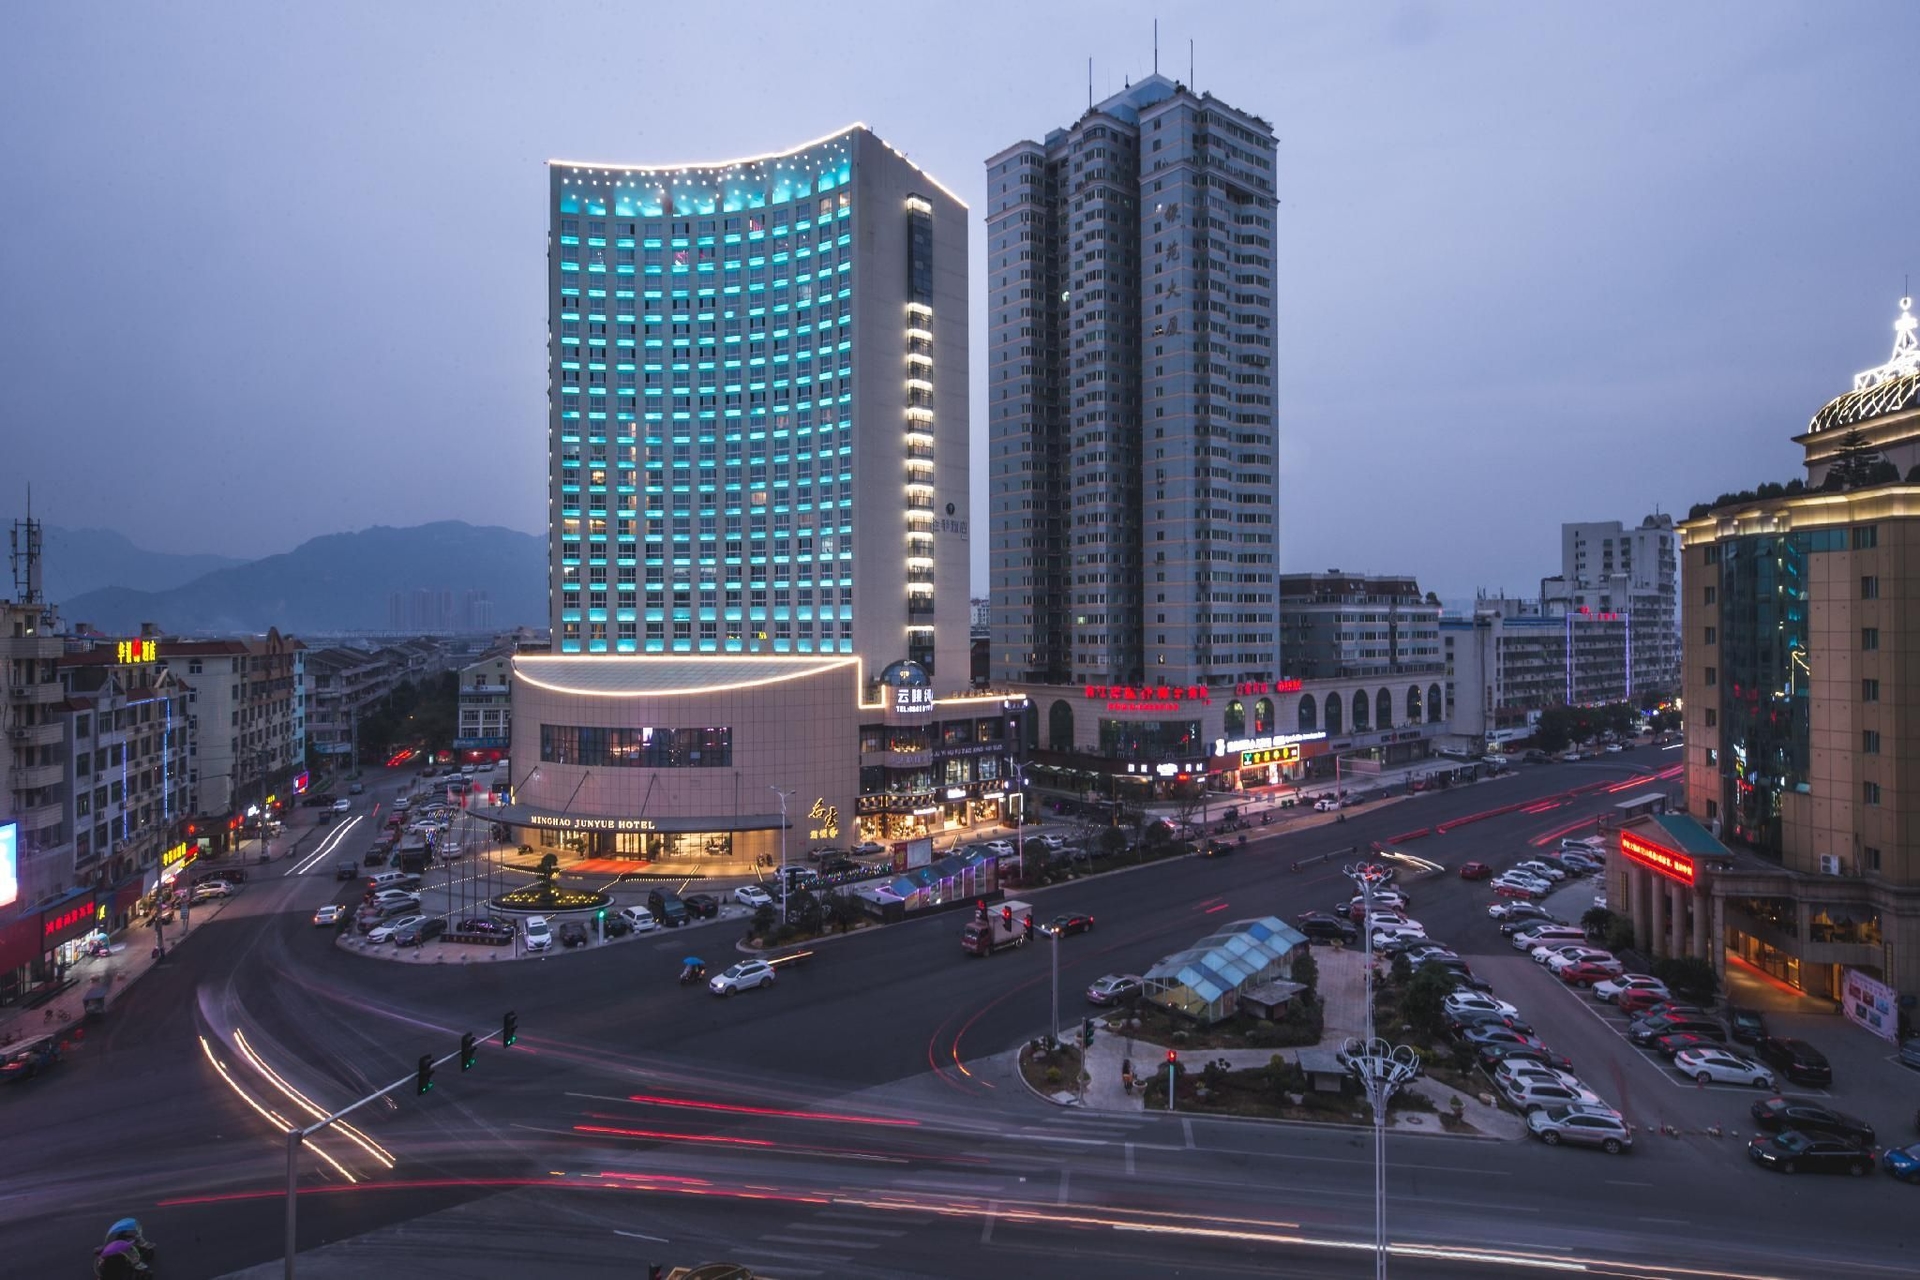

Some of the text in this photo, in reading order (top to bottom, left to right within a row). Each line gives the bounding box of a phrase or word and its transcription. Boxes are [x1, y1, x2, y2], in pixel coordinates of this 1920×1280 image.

[530, 815, 655, 830] MINGHAO JUNYUE HOTEL
